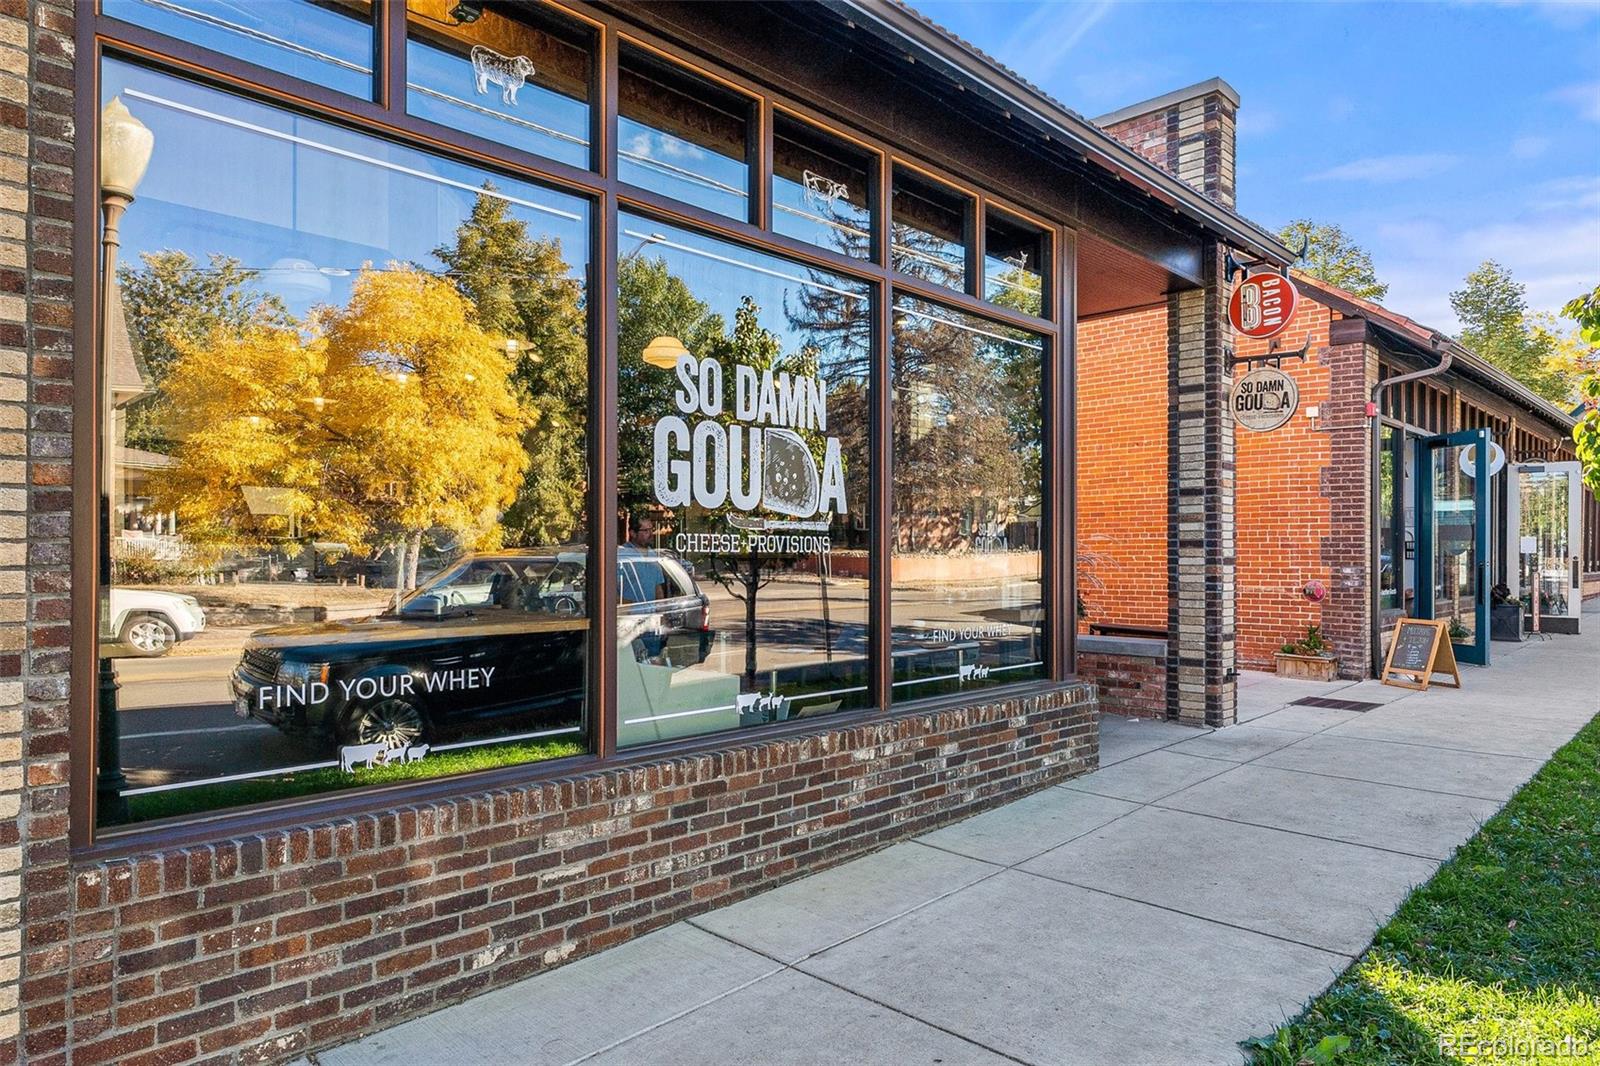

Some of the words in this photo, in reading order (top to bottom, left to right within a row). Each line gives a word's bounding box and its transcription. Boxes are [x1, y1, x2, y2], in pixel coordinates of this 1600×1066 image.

[1241, 283, 1262, 330] B
[1262, 278, 1282, 327] BACON
[675, 354, 722, 416] SO
[736, 364, 827, 431] DAMN
[1241, 382, 1253, 394] SO
[1256, 379, 1284, 392] DAMN
[653, 415, 848, 518] GOUDA
[933, 629, 956, 643] FIND
[960, 626, 984, 640] YOUR
[259, 682, 329, 709] FIND
[339, 674, 415, 701] YOUR
[424, 666, 495, 693] WHEY
